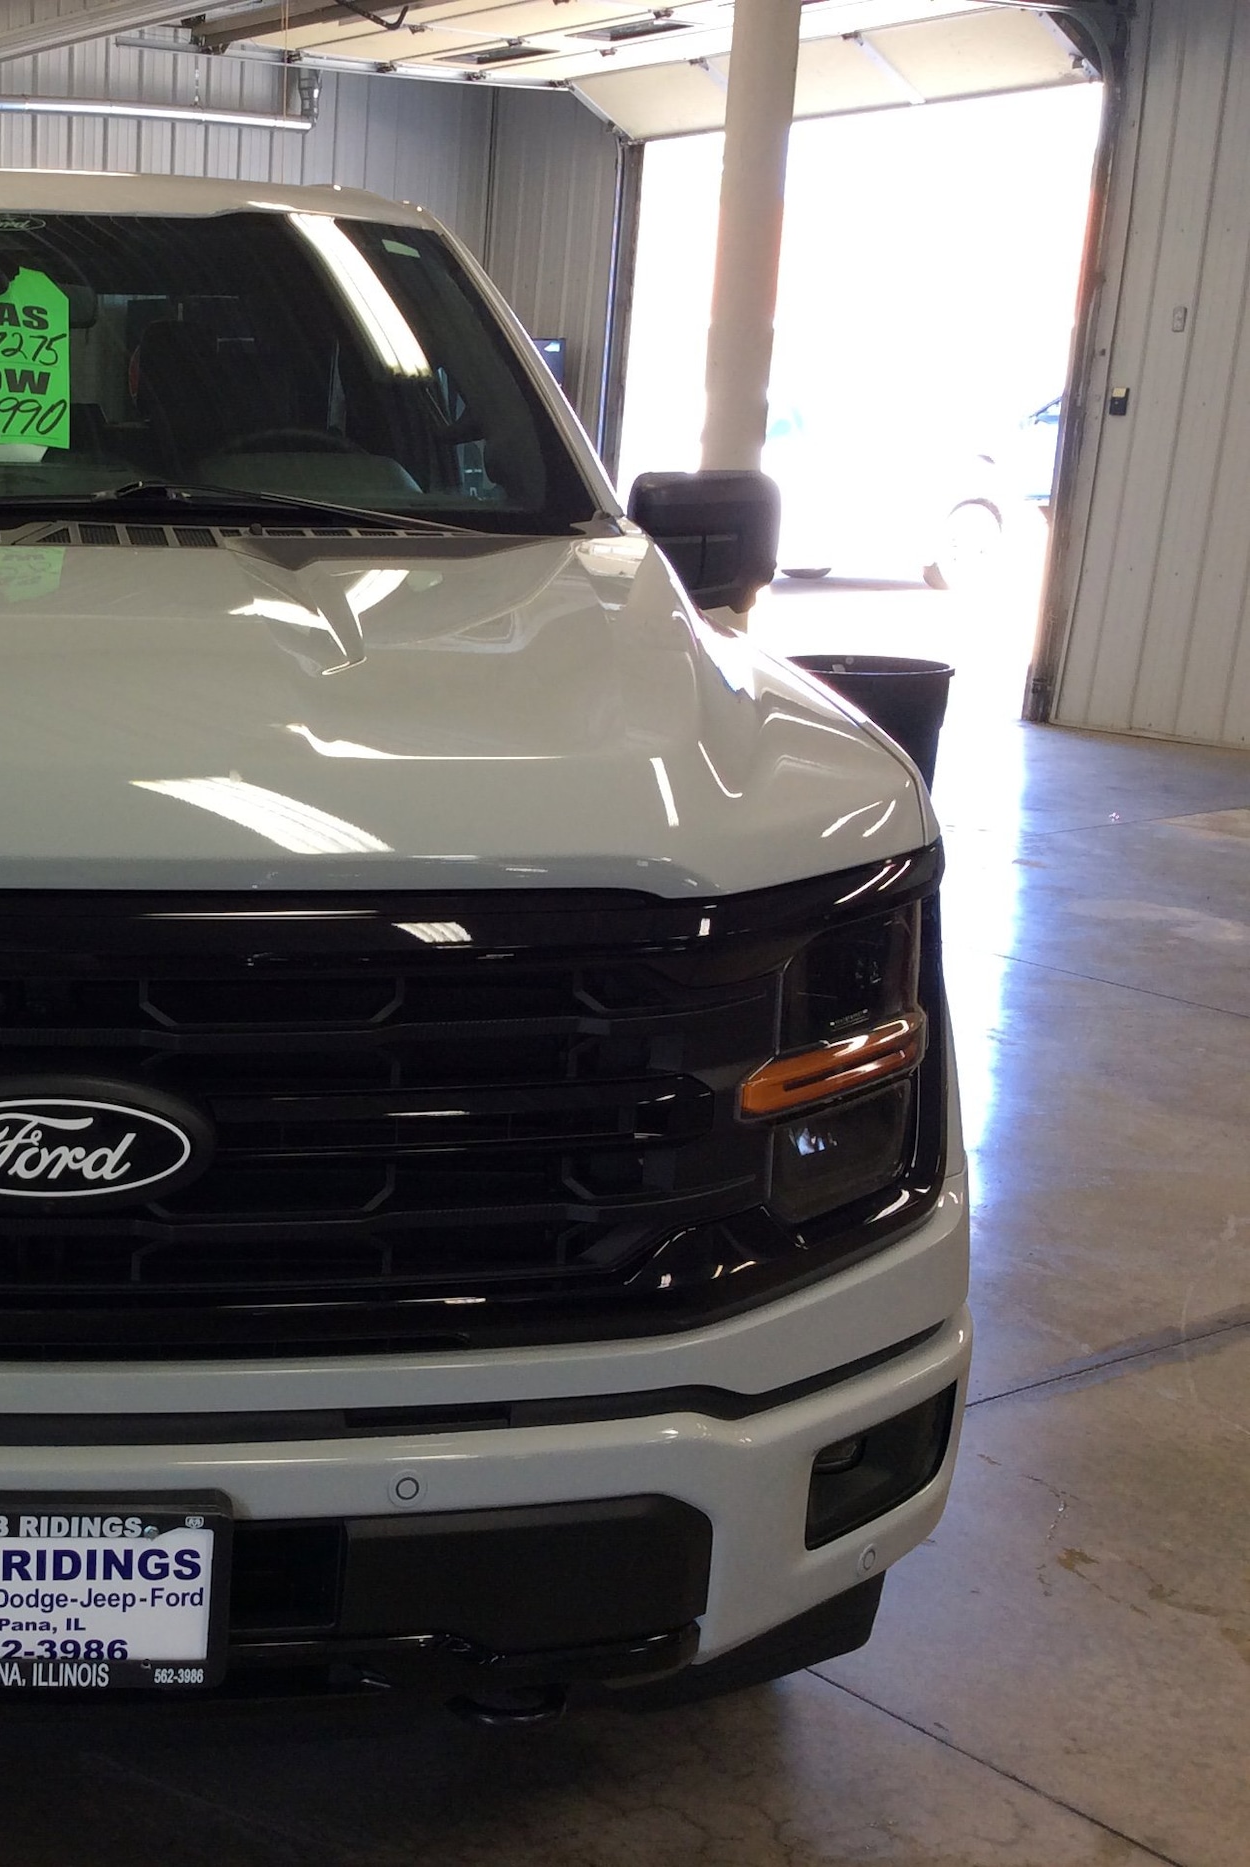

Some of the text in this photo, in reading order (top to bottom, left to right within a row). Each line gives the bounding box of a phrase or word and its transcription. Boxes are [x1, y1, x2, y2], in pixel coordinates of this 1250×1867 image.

[19, 1515, 142, 1538] RIDINGS
[2, 1549, 201, 1581] RIDINGS
[66, 1618, 86, 1631] IL
[32, 1663, 110, 1687] ILLINOIS
[154, 1668, 204, 1684] 562-3986
